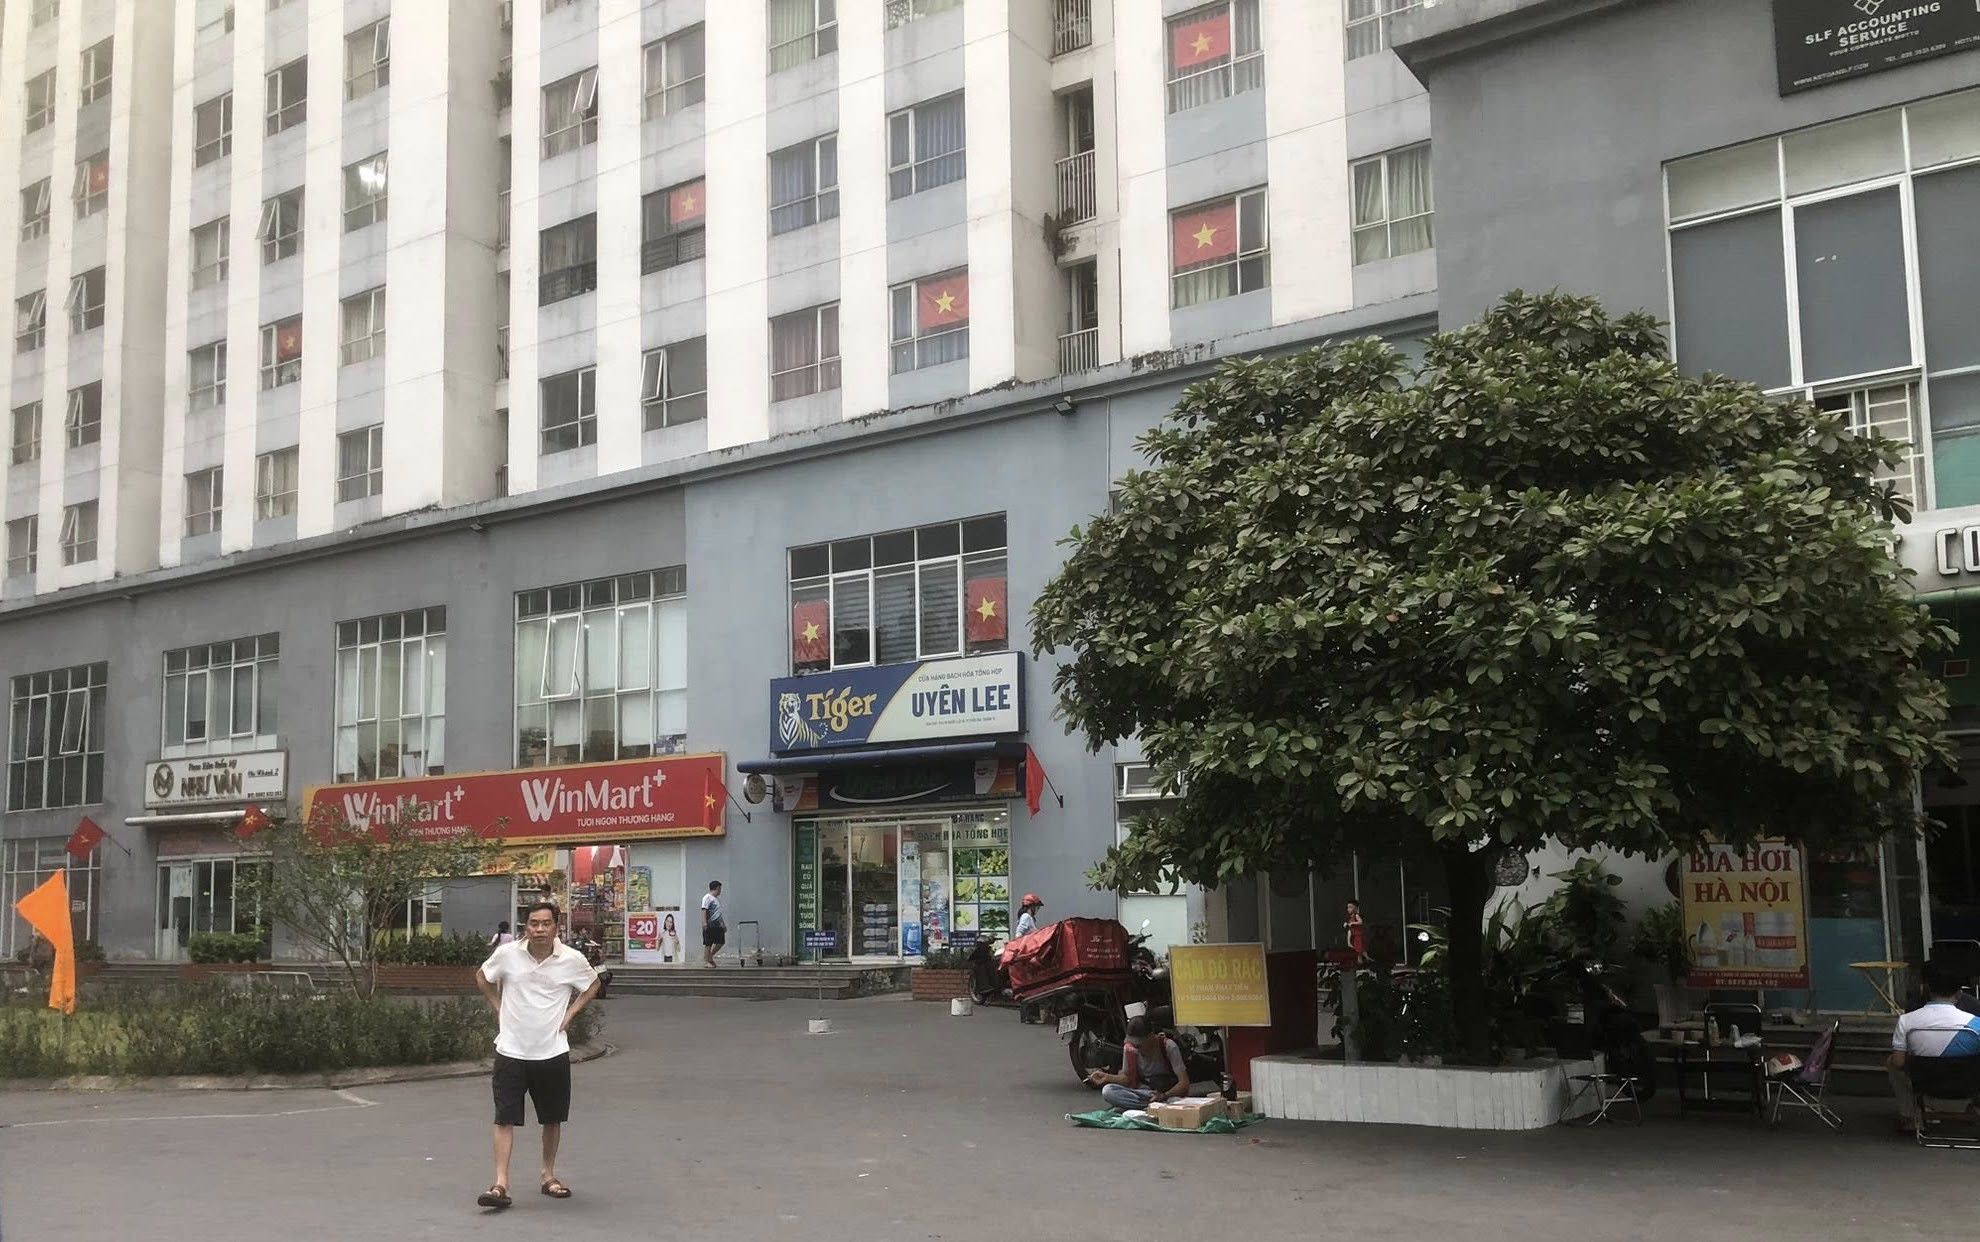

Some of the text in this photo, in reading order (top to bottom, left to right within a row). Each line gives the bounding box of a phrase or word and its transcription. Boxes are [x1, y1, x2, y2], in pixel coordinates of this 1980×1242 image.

[1805, 2, 1941, 45] SLF ACCOUNTING
[1839, 22, 1908, 47] SERVICE
[805, 685, 878, 733] Tiger
[912, 683, 1011, 718] UYÊN LEE
[595, 816, 618, 827] NGON
[965, 825, 989, 840] TỔNG
[1690, 849, 1793, 872] BIA HƠI
[1694, 876, 1791, 908] HÀ NỘI
[1232, 953, 1262, 980] RÁC
